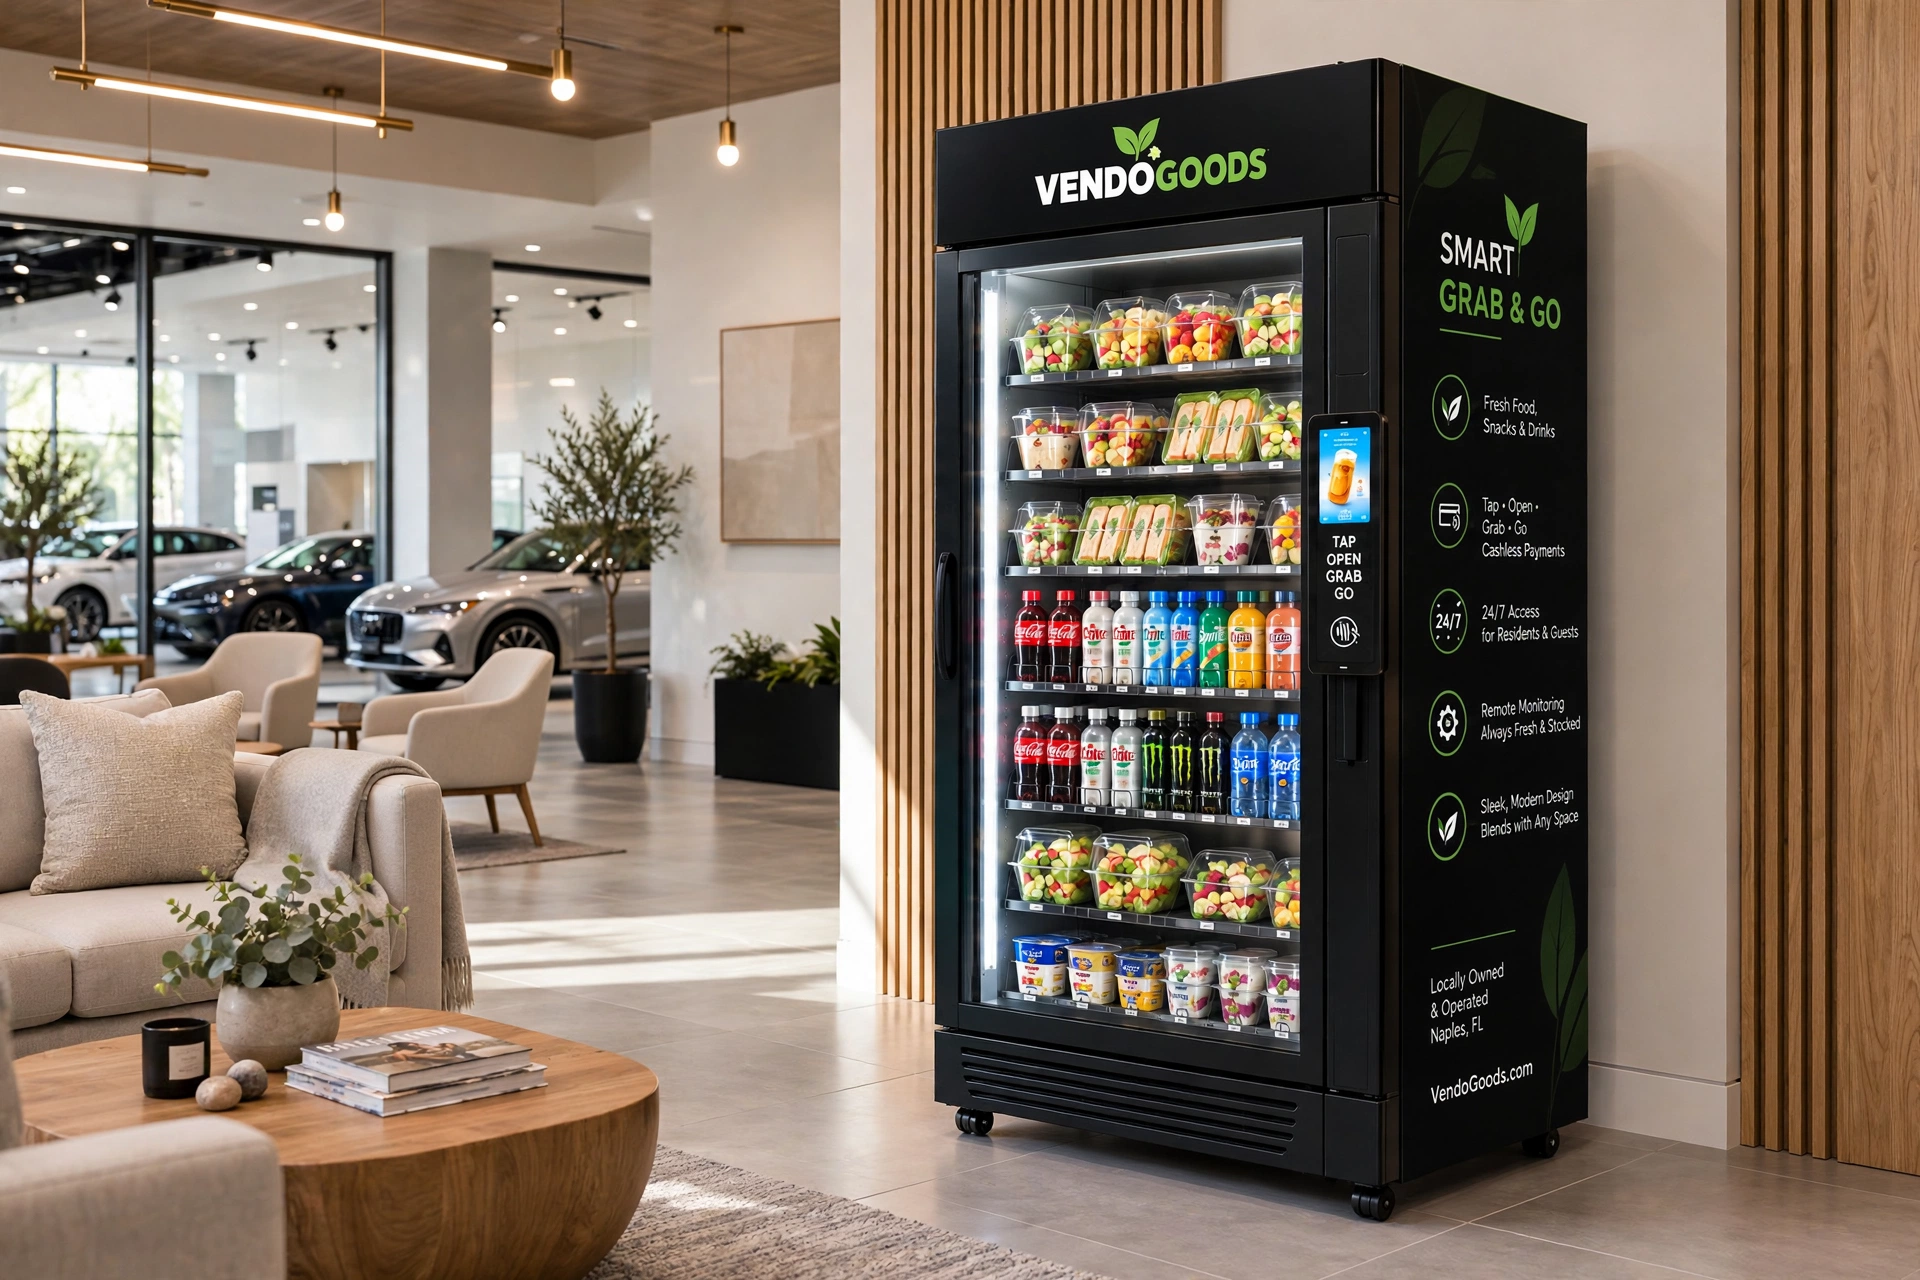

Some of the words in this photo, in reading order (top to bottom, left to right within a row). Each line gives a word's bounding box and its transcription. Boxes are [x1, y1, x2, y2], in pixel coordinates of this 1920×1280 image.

[1034, 147, 1267, 206] VENDOGOODS
[1440, 231, 1515, 276] SMART
[1440, 279, 1503, 319] GRAB
[1510, 292, 1524, 323] &
[1531, 296, 1560, 329] GO
[1484, 395, 1510, 412] Fresh
[1513, 398, 1537, 416] Food,
[1484, 418, 1516, 435] Snacks
[1519, 421, 1525, 436] &
[1529, 422, 1555, 438] Drinks
[1482, 497, 1499, 516] Tap
[1508, 498, 1532, 516] Open
[1482, 519, 1505, 534] Grab
[1514, 520, 1527, 535] Go
[1332, 536, 1356, 548] TAP
[1482, 542, 1522, 557] Cashless
[1524, 543, 1565, 560] Payments
[1327, 553, 1361, 565] OPEN
[1326, 570, 1362, 582] GRAB
[1335, 587, 1354, 599] GO
[1436, 613, 1461, 630] 24/7
[1482, 605, 1505, 620] 24/7
[1508, 605, 1539, 618] Access
[1482, 628, 1495, 642] for
[1498, 626, 1540, 641] Residents
[1542, 626, 1548, 639] &
[1551, 626, 1579, 638] Guests
[1482, 702, 1516, 717] Remote
[1519, 697, 1564, 713] Monitoring
[1481, 725, 1512, 742] Always
[1515, 721, 1537, 736] Fresh
[1540, 720, 1546, 733] &
[1548, 716, 1580, 732] Stocked
[1481, 796, 1508, 814] Sleek,
[1547, 788, 1573, 804] Design
[1481, 819, 1511, 838] Blends
[1514, 816, 1531, 832] with
[1535, 814, 1552, 830] Any
[1554, 811, 1578, 828] Space
[1431, 971, 1465, 994] Locally
[1469, 962, 1503, 984] Owned
[1431, 1003, 1438, 1018] &
[1441, 989, 1489, 1017] Operated
[1431, 1022, 1468, 1044] Naples,
[1472, 1016, 1483, 1032] FL
[1431, 1063, 1532, 1103] VendoGoods.com
